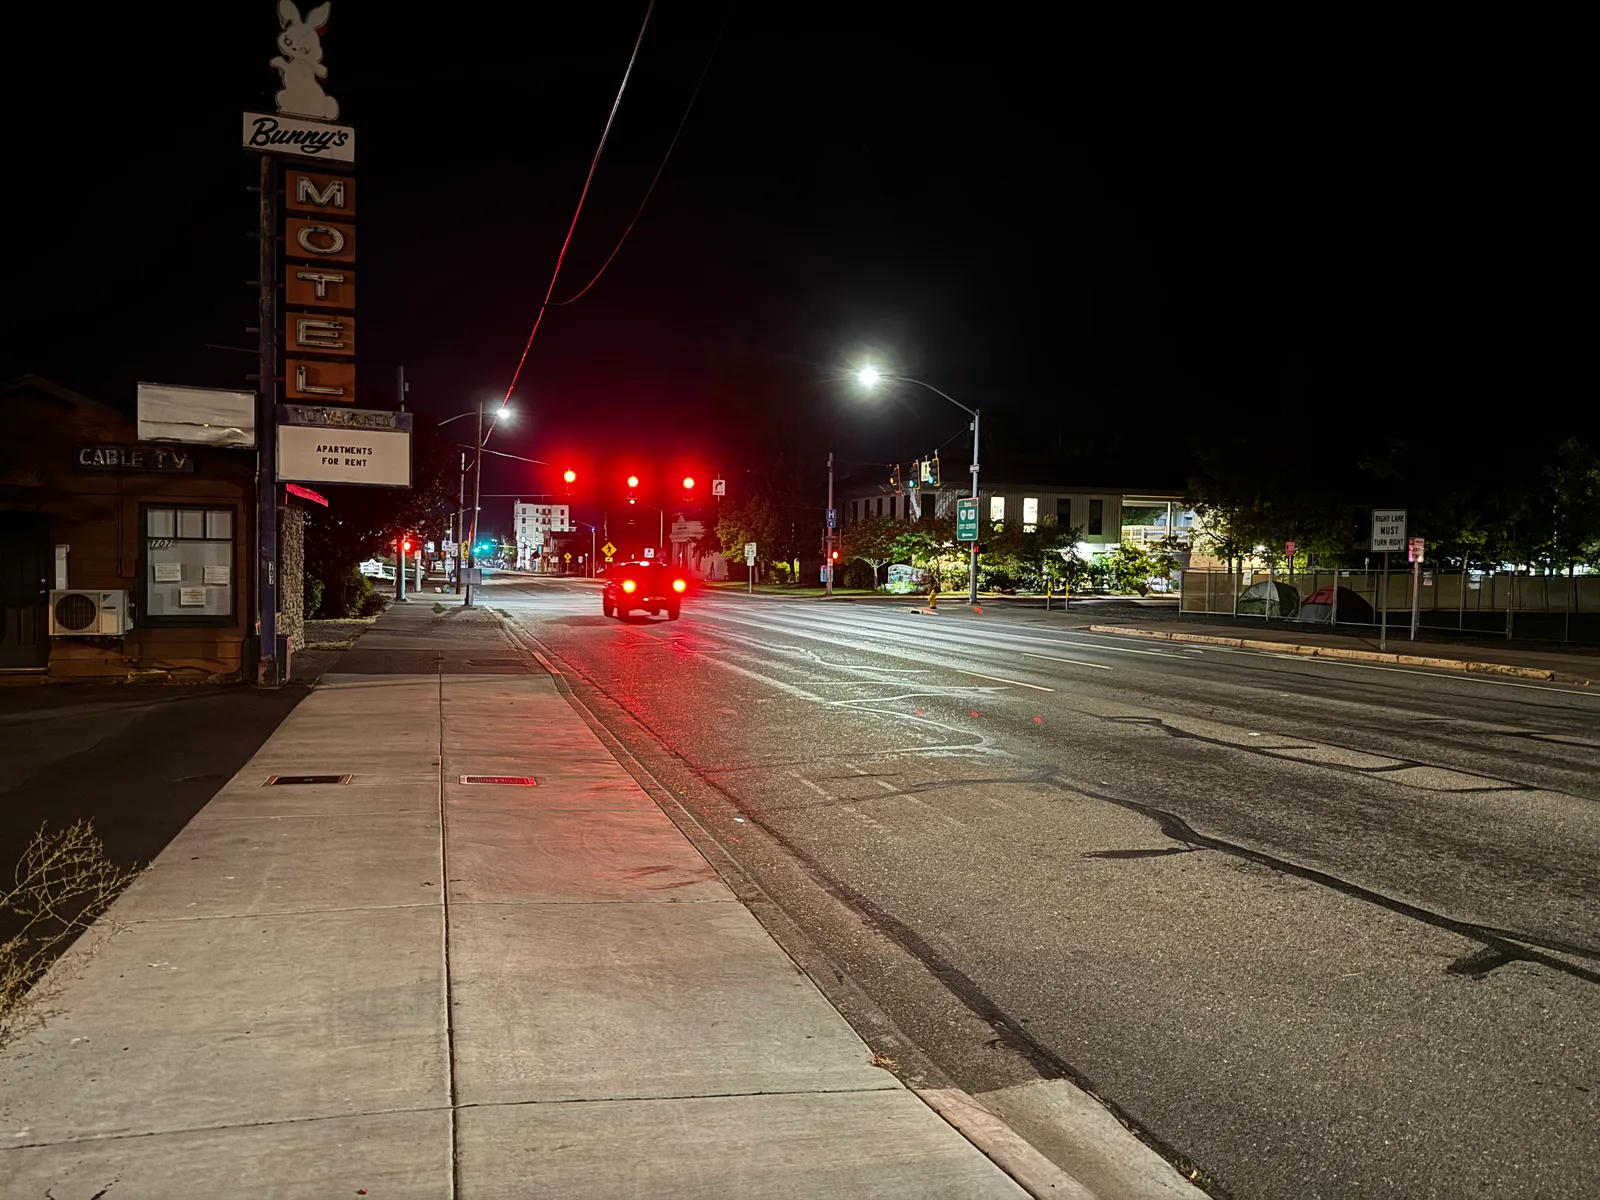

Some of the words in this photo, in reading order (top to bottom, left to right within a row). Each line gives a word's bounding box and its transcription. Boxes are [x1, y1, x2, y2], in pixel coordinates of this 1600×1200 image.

[249, 118, 348, 154] Bunny's
[296, 176, 344, 394] MOTEL
[321, 407, 396, 427] VACANCY
[80, 448, 143, 467] CABLE
[316, 445, 372, 455] APARTMENTS
[345, 458, 367, 467] RENT
[1380, 526, 1398, 535] MUST
